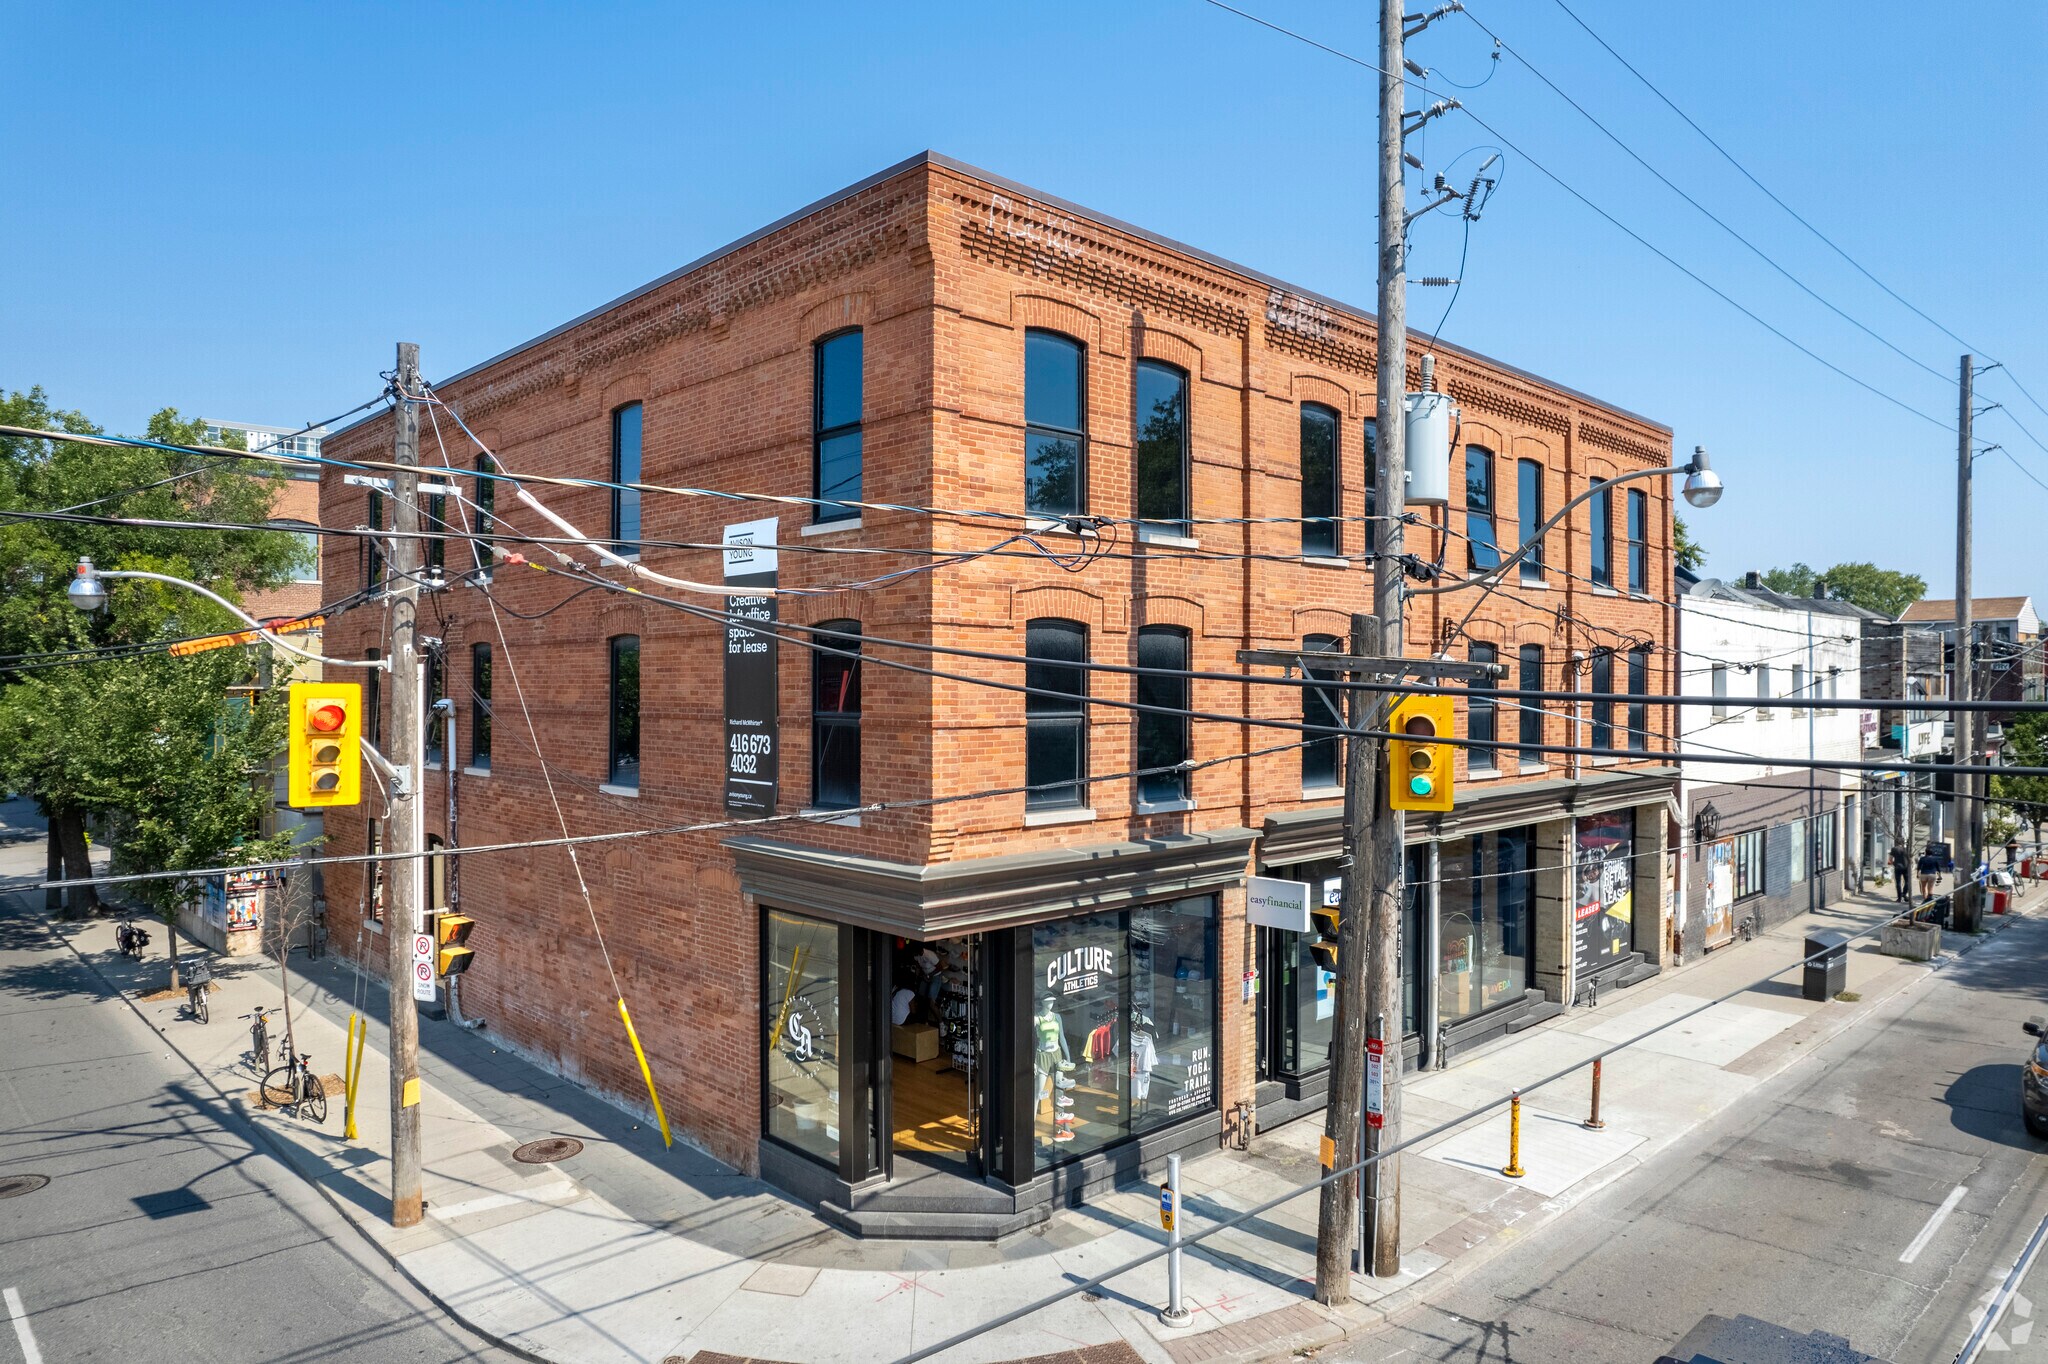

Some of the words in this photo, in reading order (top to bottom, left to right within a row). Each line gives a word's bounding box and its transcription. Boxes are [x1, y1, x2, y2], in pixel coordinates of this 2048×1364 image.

[729, 548, 753, 560] YOUNG
[729, 595, 767, 607] Creative
[745, 607, 770, 620] office
[728, 640, 741, 653] for
[743, 639, 768, 653] lease
[730, 733, 749, 753] 416
[750, 734, 771, 755] 673
[730, 753, 757, 774] 4032
[1604, 867, 1628, 884] RETAIL
[1250, 895, 1302, 910] easyfinancial
[1603, 887, 1627, 906] LEASE
[1577, 902, 1600, 919] LEASED
[1047, 946, 1113, 989] CULTURE
[416, 988, 431, 996] ROUTE
[1063, 975, 1098, 992] ATHLETICS
[1490, 980, 1512, 994] AVEDA
[1192, 1046, 1211, 1062] RUN.
[1187, 1060, 1211, 1077] YOGA.
[1184, 1073, 1211, 1092] TRAIN.
